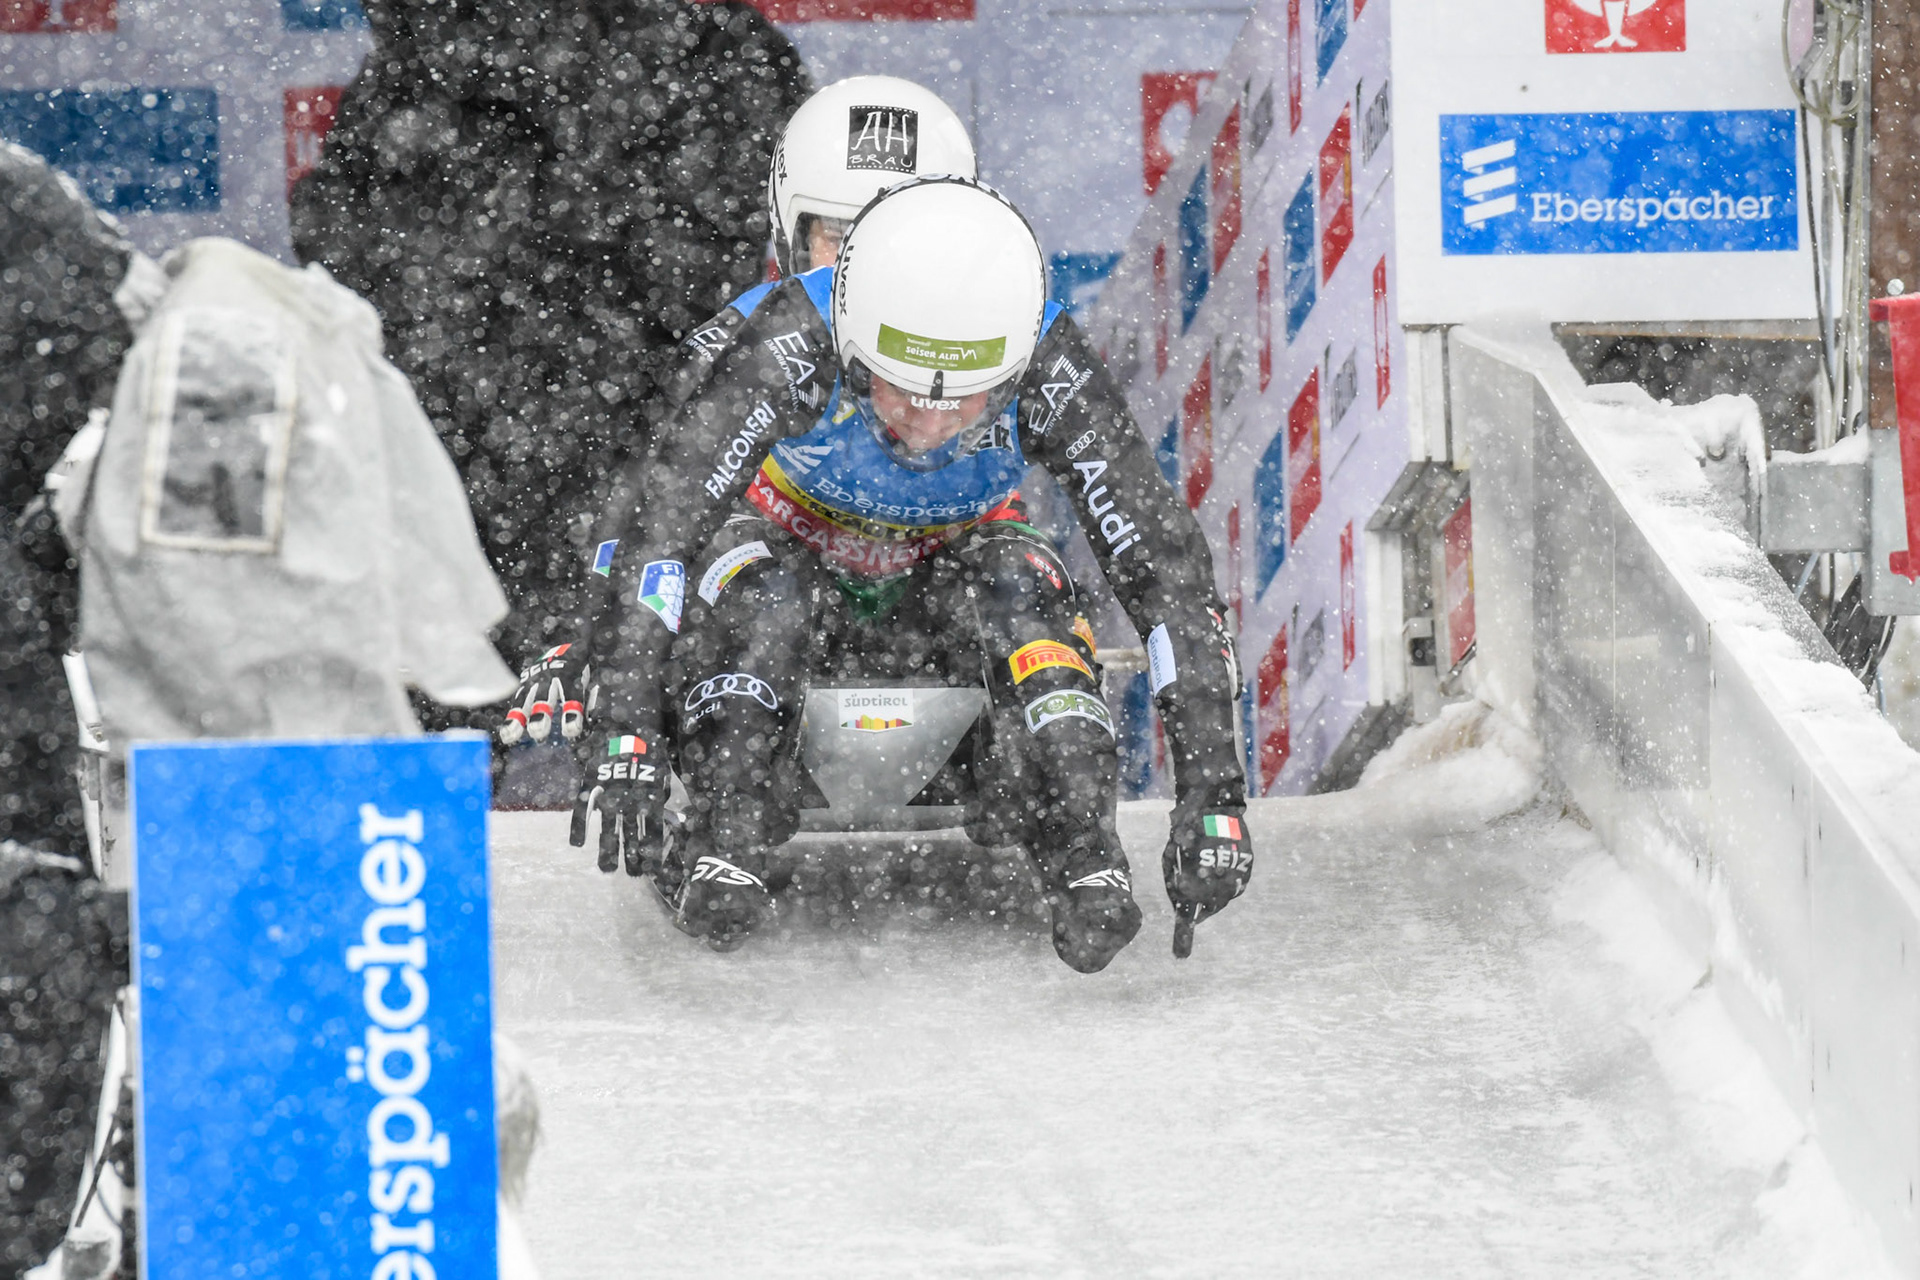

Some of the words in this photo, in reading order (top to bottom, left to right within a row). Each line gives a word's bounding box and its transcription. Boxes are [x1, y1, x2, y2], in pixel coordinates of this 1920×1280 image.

[1530, 190, 1774, 229] Eberspächer
[911, 396, 961, 411] uvex
[704, 401, 777, 500] FALCONERI
[1072, 460, 1142, 556] Audi
[597, 757, 655, 782] SEIZ
[1199, 844, 1253, 873] SEIZ
